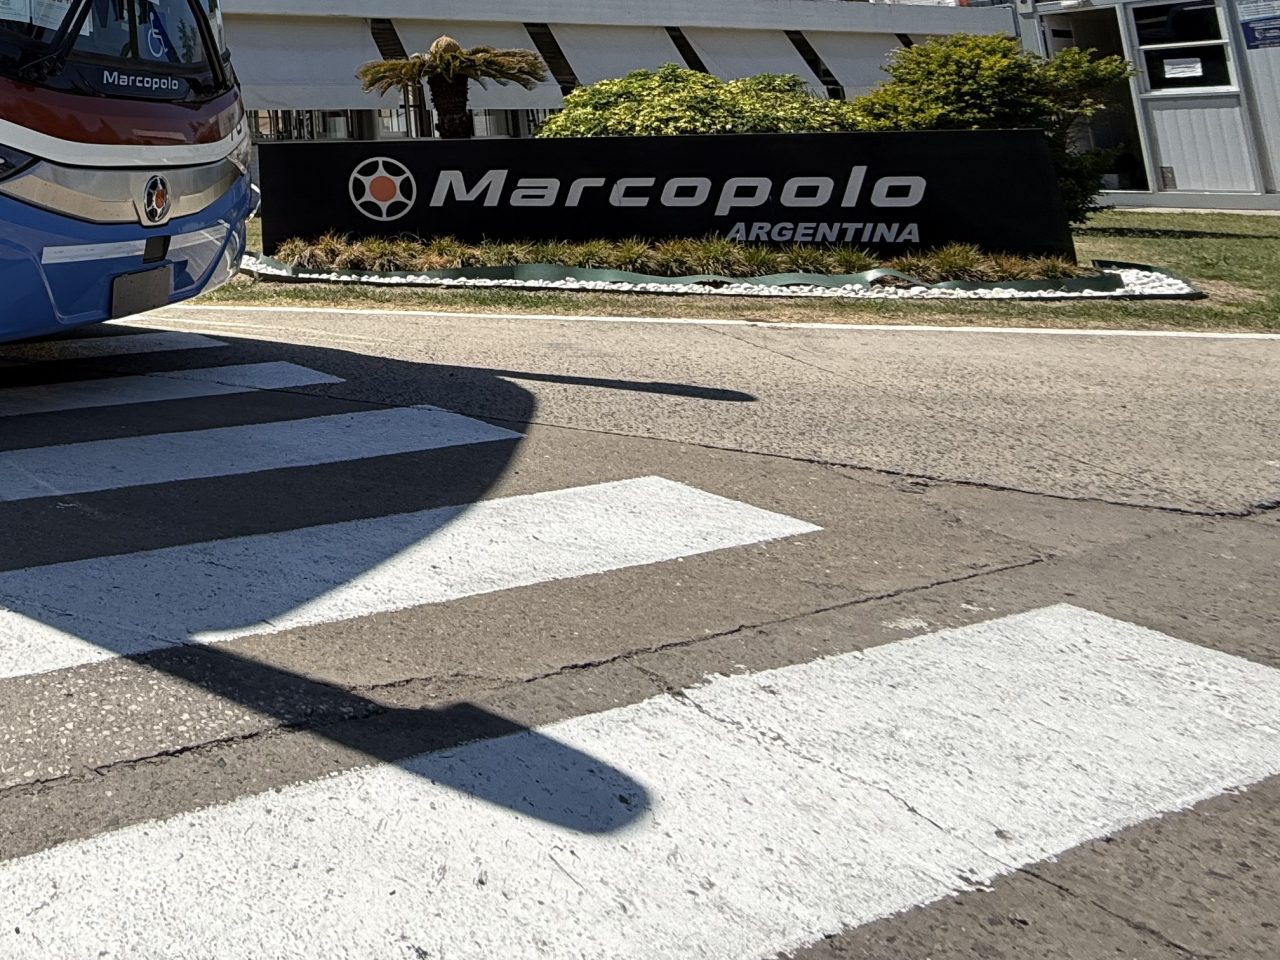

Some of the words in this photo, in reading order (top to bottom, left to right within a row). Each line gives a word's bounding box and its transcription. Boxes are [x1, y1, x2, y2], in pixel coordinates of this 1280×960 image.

[102, 70, 179, 90] Marcopolo
[428, 165, 927, 216] Marcopolo
[727, 222, 921, 243] ARGENTINA
